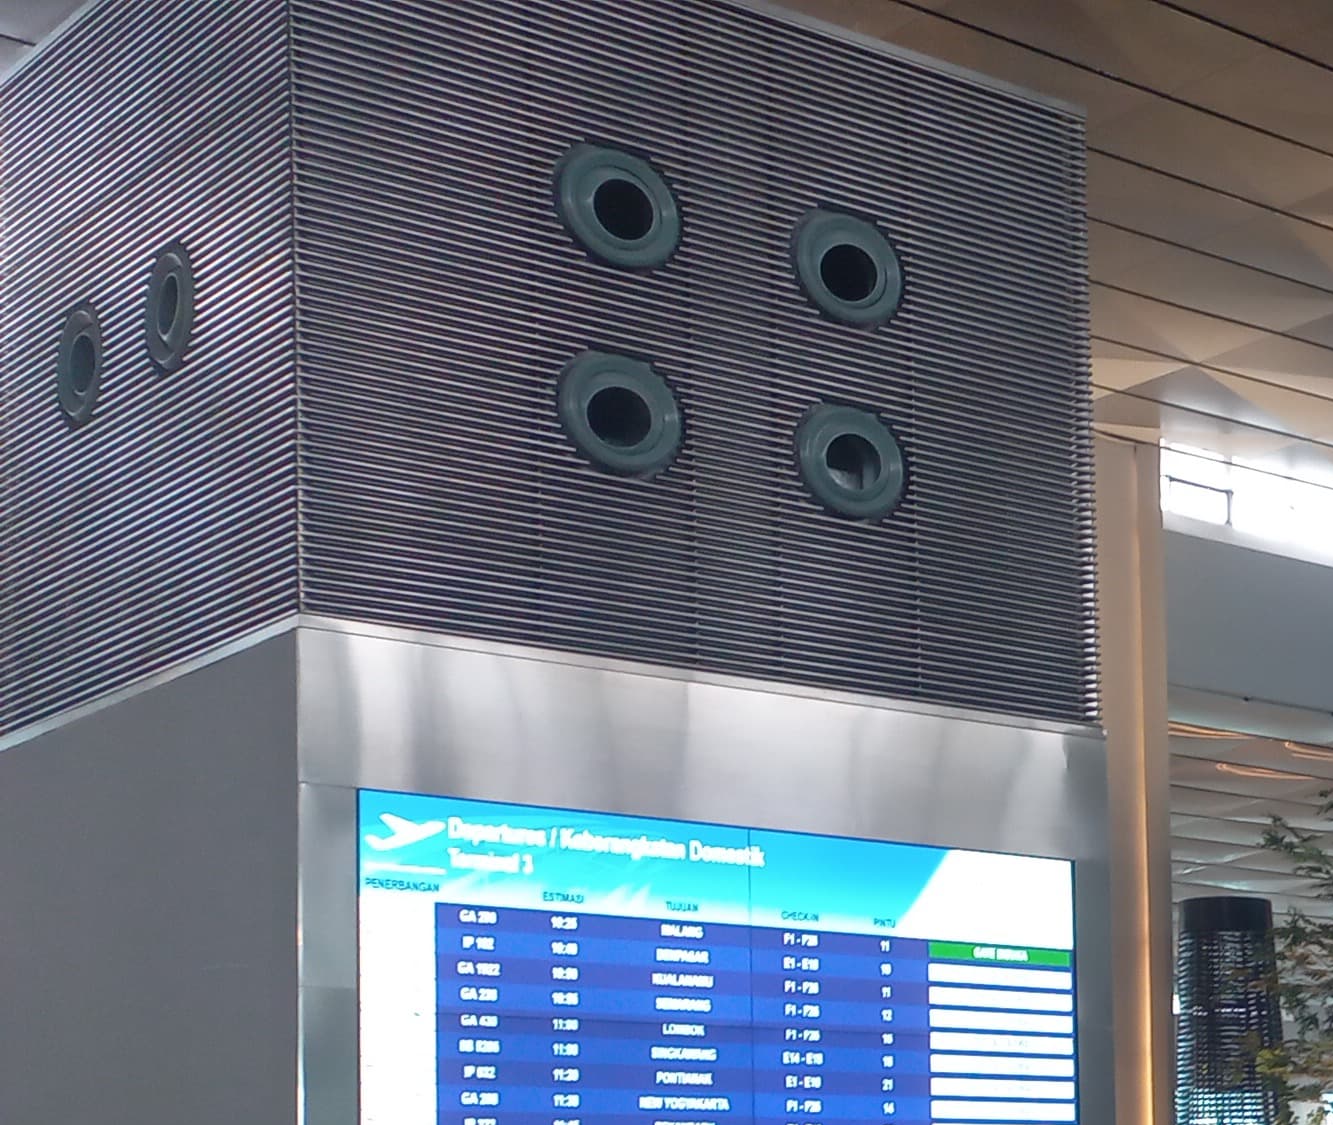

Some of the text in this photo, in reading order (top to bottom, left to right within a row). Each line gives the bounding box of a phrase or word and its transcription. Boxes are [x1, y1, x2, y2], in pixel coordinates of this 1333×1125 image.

[447, 815, 546, 846] Departures
[559, 827, 686, 861] Keberangkatan
[689, 839, 766, 868] Domestik
[446, 847, 520, 874] Terminal
[365, 877, 440, 892] PENERBANGAN
